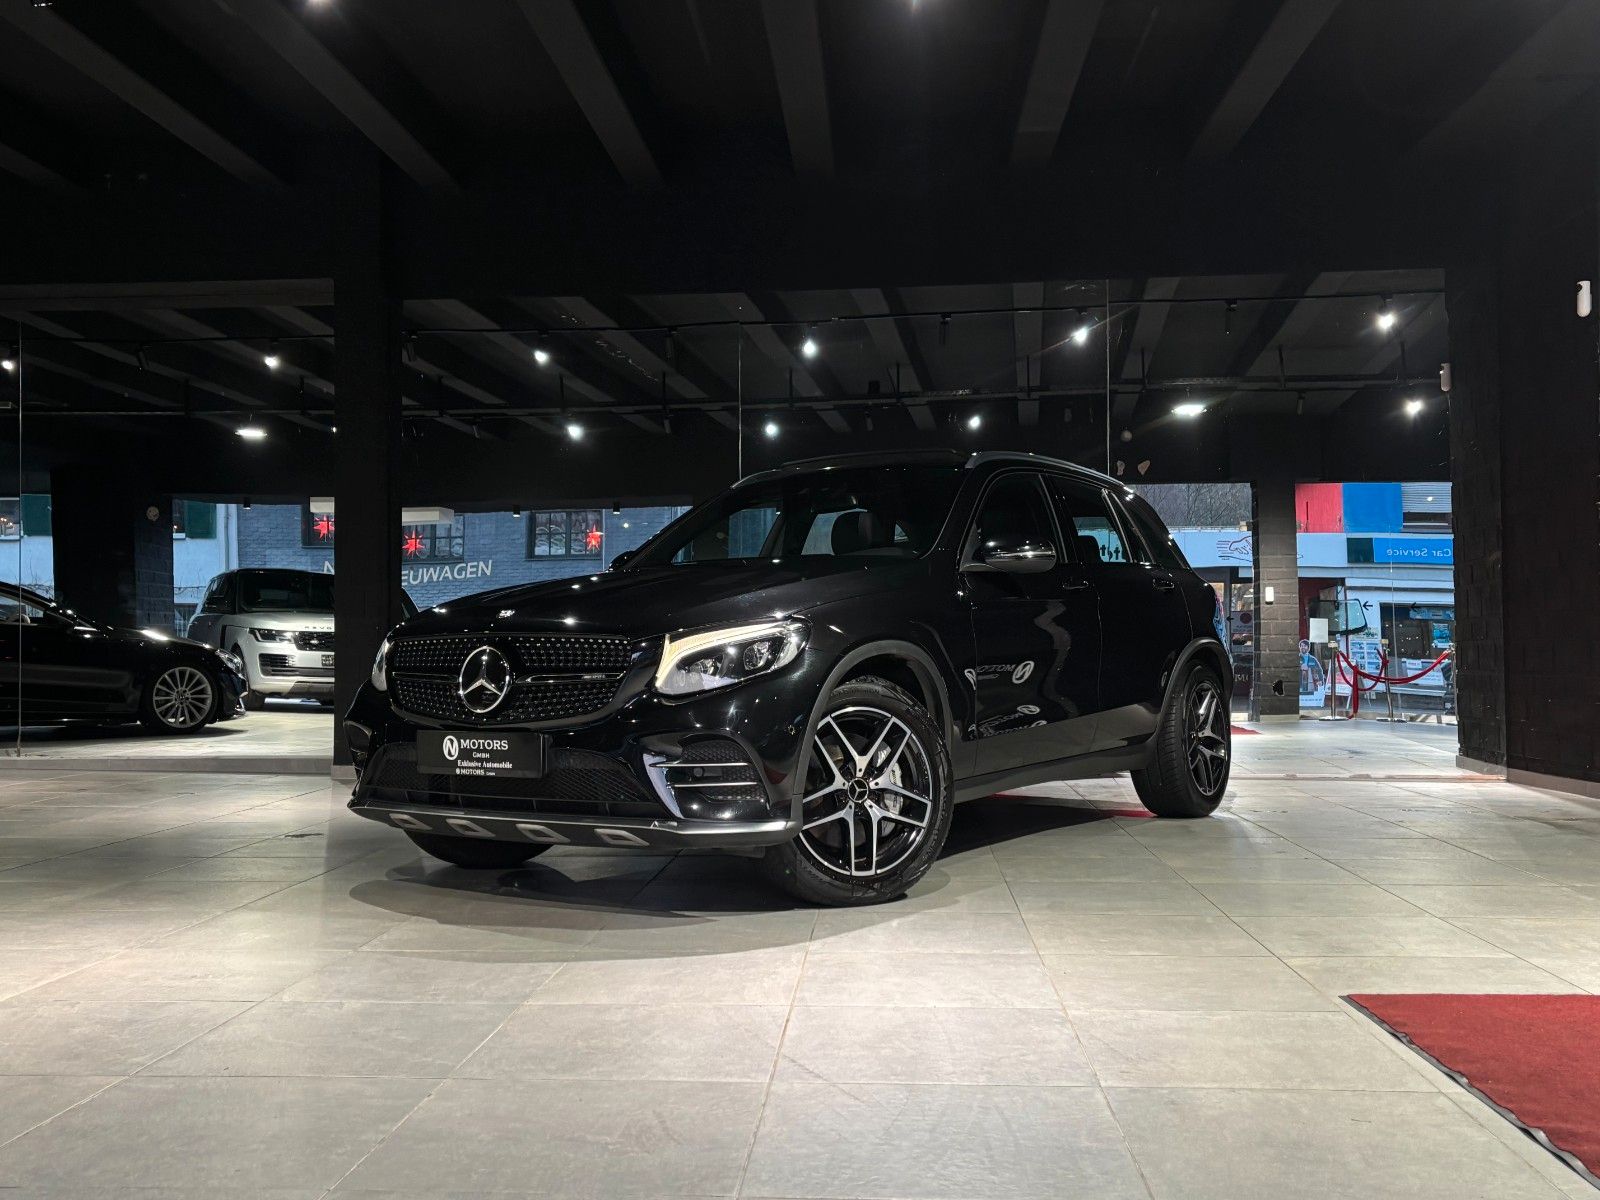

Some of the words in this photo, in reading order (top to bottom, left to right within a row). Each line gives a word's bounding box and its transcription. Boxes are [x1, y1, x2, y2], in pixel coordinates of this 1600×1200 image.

[401, 559, 492, 586] EUWAGEN
[460, 739, 508, 751] MOTORS
[482, 761, 513, 769] Automobile
